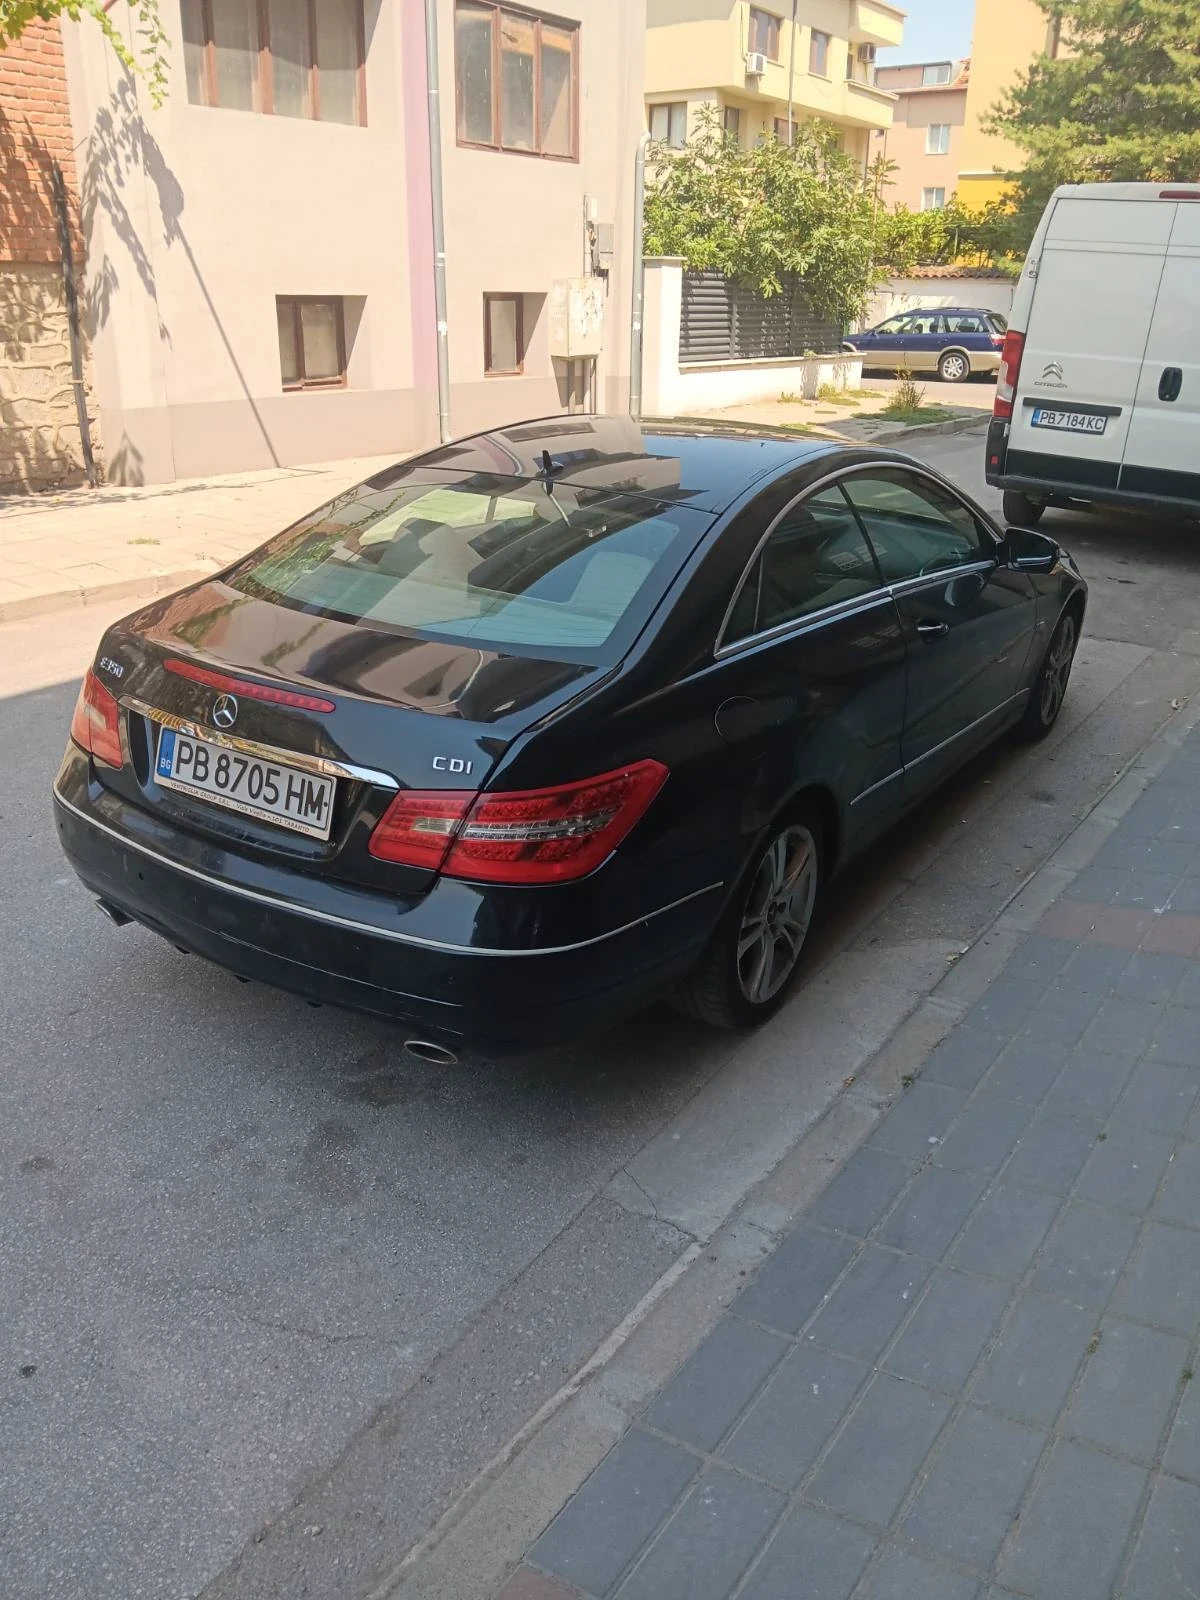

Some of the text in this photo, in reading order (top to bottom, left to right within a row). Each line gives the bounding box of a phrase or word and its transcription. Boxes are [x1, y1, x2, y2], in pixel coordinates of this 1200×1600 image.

[1057, 414, 1085, 428] 7184
[1086, 416, 1104, 430] KC
[160, 757, 171, 770] BG
[432, 756, 472, 774] CDI
[175, 740, 326, 821] PB 8705 HM
[283, 819, 310, 833] TARANTO
